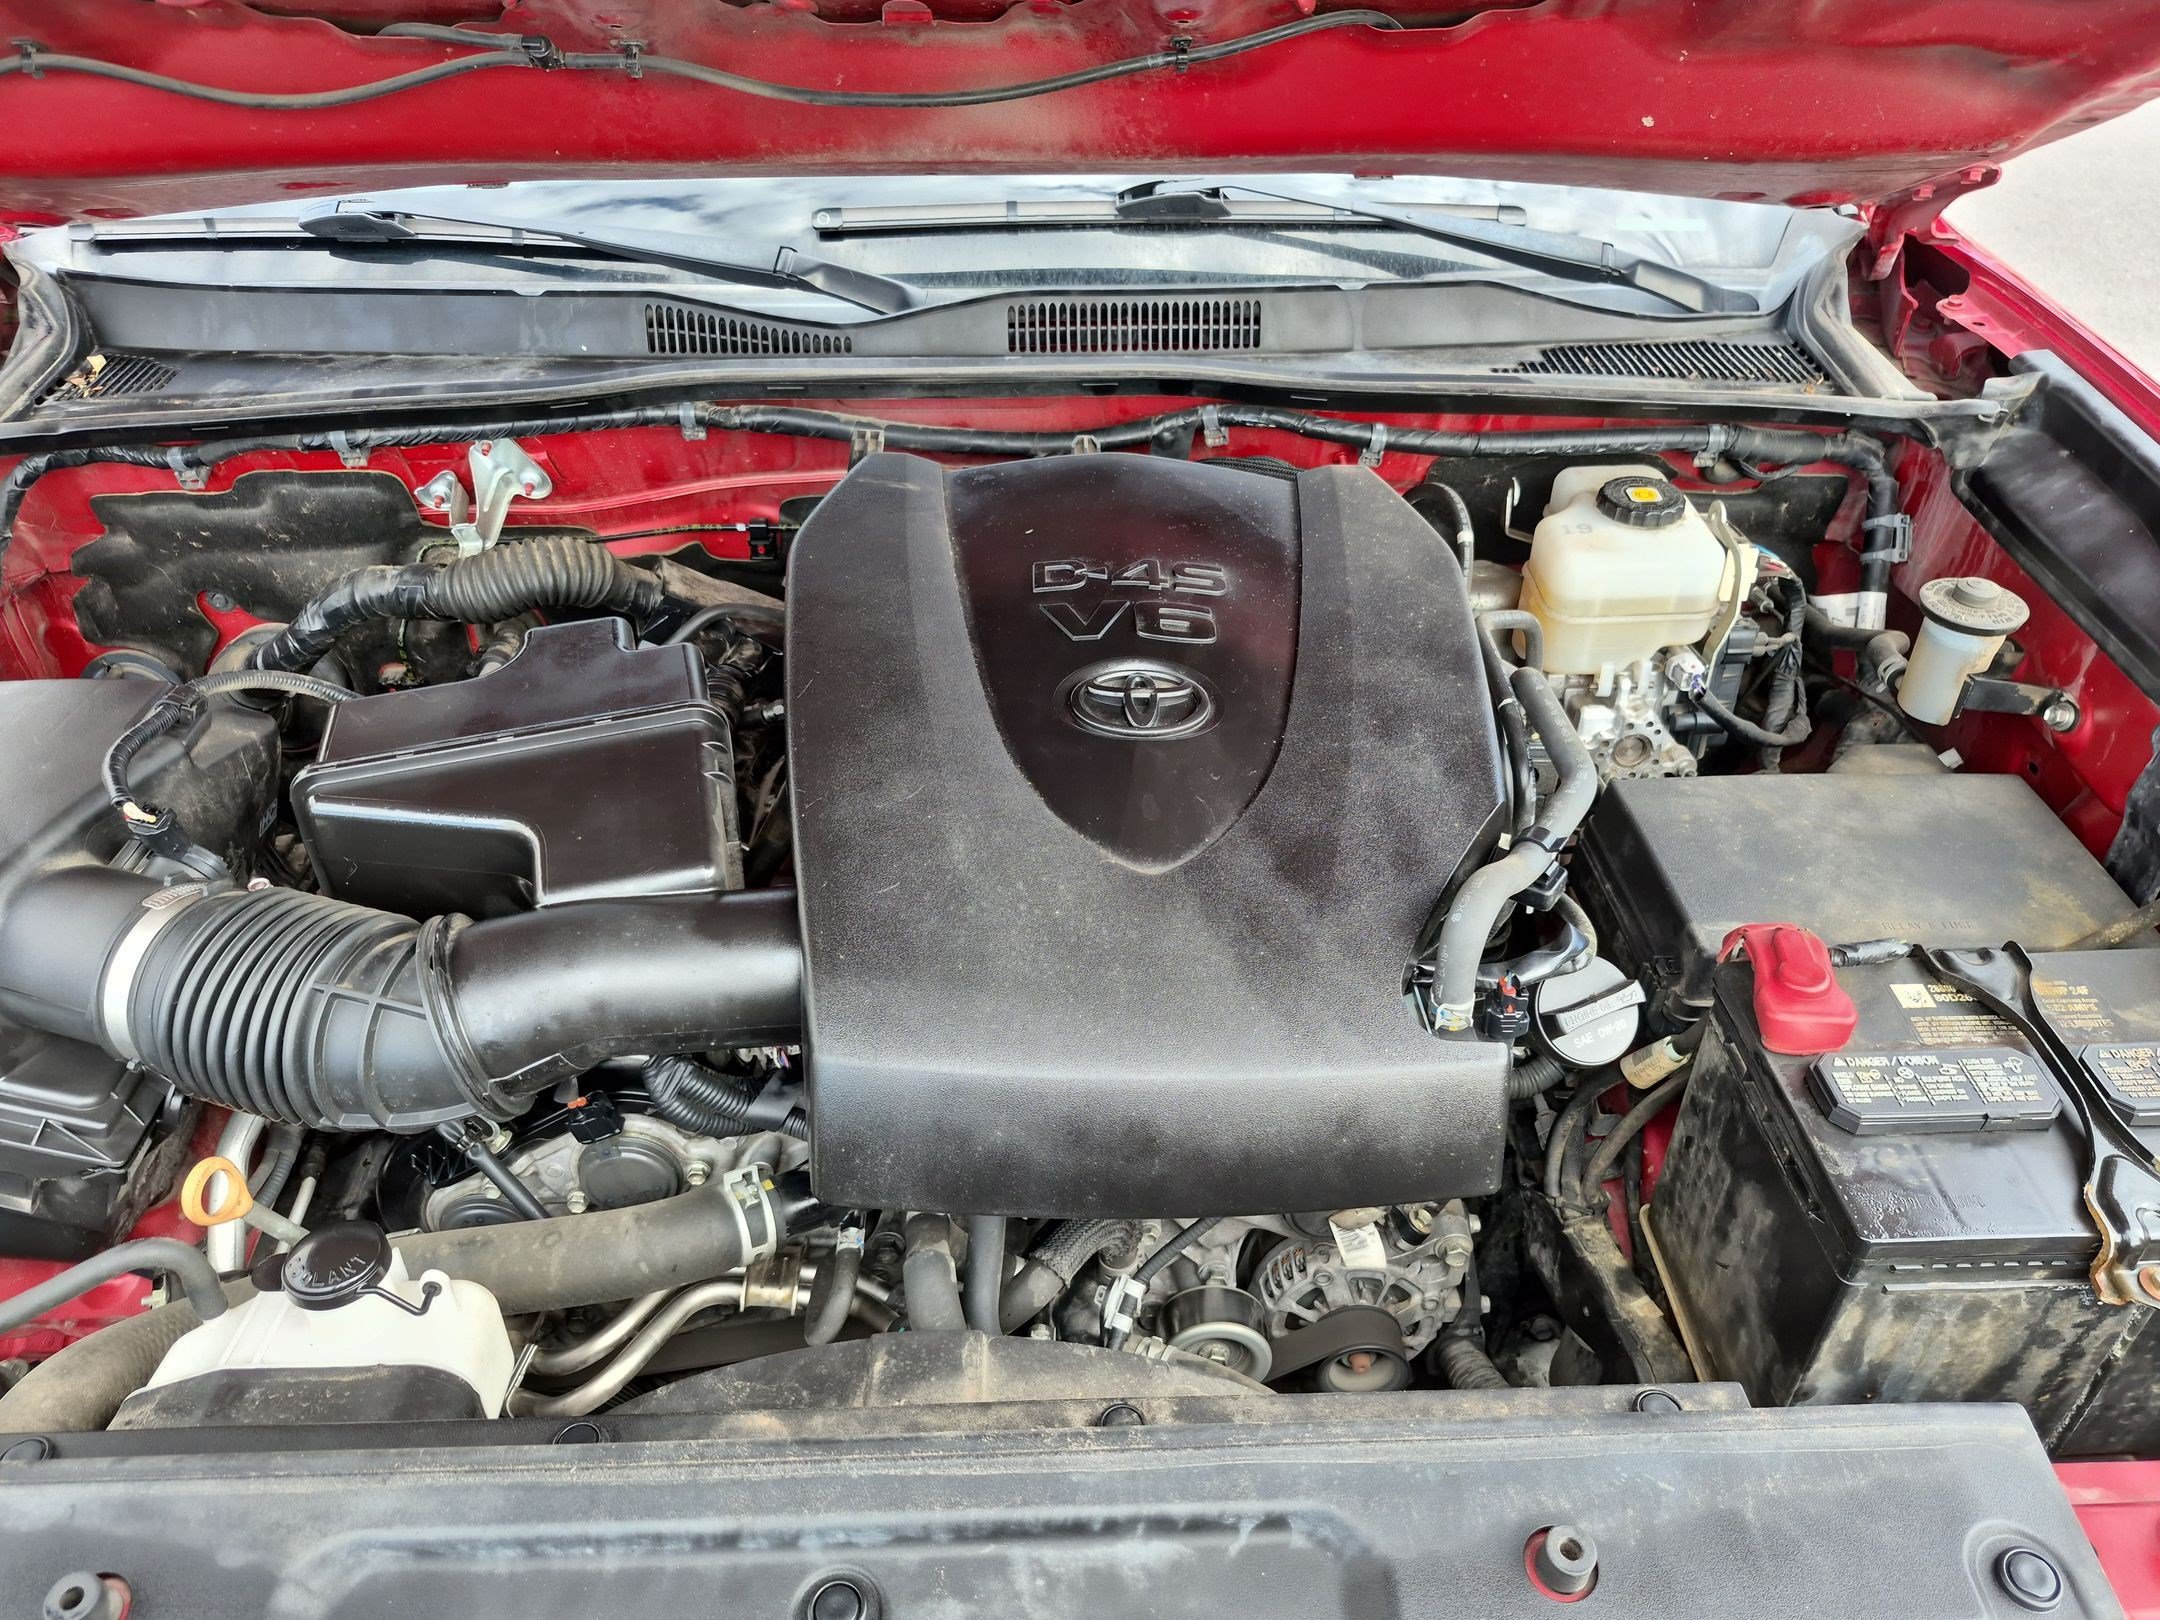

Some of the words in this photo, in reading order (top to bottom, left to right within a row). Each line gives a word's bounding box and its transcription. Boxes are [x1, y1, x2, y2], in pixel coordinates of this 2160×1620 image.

[1032, 558, 1228, 596] D-4S
[1038, 600, 1218, 644] V6
[1563, 1006, 1599, 1027] ENGINE
[2066, 1003, 2098, 1012] AMPS
[1573, 1032, 1595, 1049] SAE
[1597, 1019, 1627, 1039] 0W-20
[1845, 1056, 1891, 1067] DANGER
[2109, 1048, 2155, 1059] DANGER
